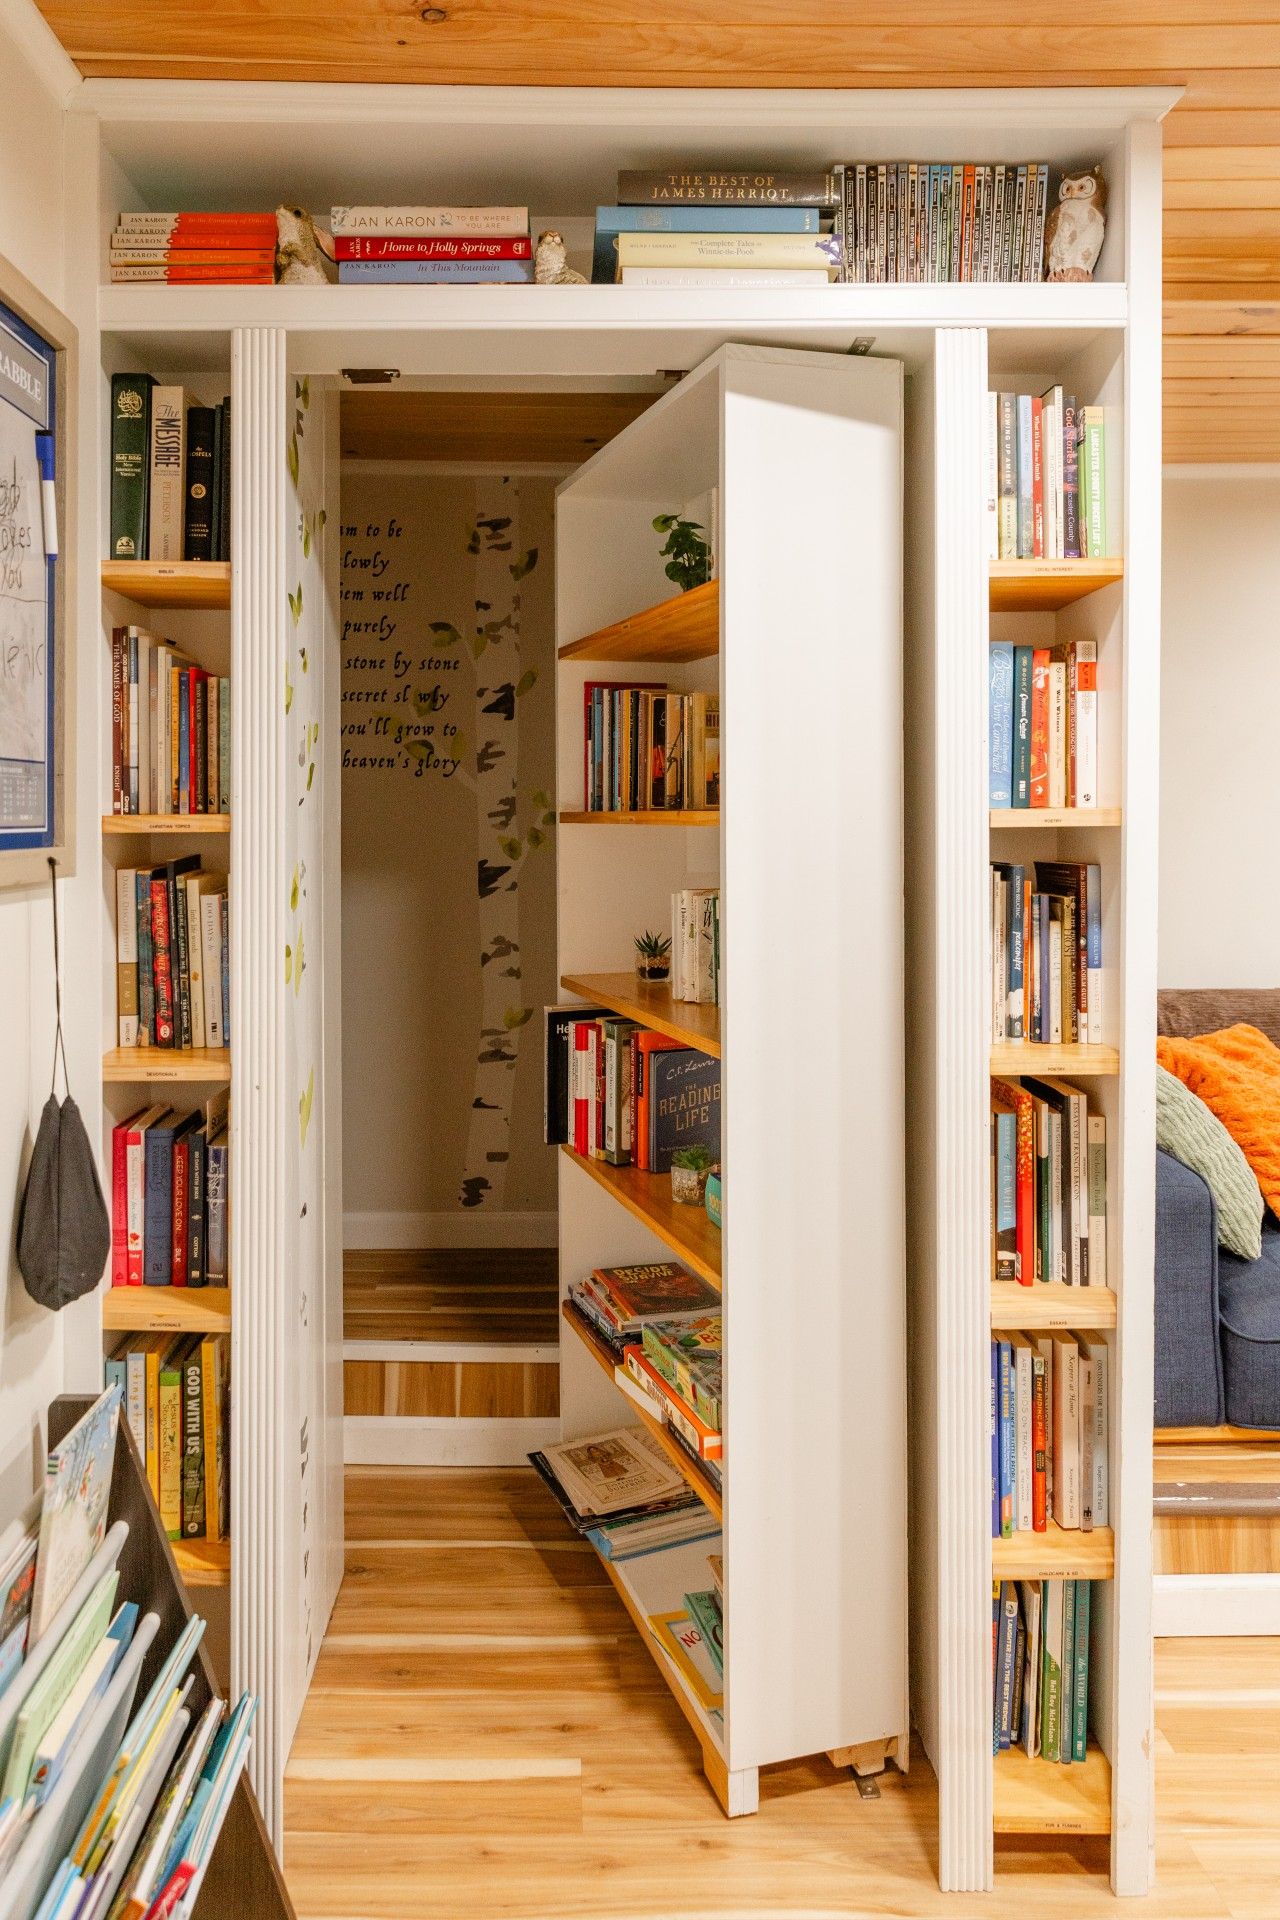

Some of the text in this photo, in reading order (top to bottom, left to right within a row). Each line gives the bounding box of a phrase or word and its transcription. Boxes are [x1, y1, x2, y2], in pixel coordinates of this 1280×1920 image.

[651, 188, 789, 199] JAMES HERRIOT
[668, 175, 775, 187] THE BEST OF
[350, 217, 436, 227] JAN KARON
[379, 241, 501, 255] Home to Holly Springs
[417, 263, 500, 272] In This Mountain
[156, 404, 180, 418] The
[1065, 407, 1075, 428] God
[154, 418, 181, 468] MESSAGE
[1004, 444, 1011, 455] UP
[1065, 430, 1075, 464] Stories
[1090, 428, 1101, 545] LANCASTER COUNTY BUCKET LIST
[366, 524, 380, 538] to
[387, 519, 403, 538] be
[1066, 517, 1075, 543] County
[340, 550, 390, 577] lowly
[372, 583, 410, 602] well
[343, 615, 396, 641] purely
[344, 651, 460, 677] stone by stone
[991, 649, 1011, 699] Breezes
[114, 691, 121, 701] OF
[341, 689, 388, 703] secret
[340, 717, 457, 744] you'll grow to
[992, 702, 1003, 773] Amy Carmichael
[342, 749, 460, 778] heaven's glory
[155, 895, 166, 970] WHISPERS OF HIS POWER
[1063, 928, 1073, 958] FROST
[1012, 931, 1022, 972] peacemaker
[159, 976, 169, 1017] CARMICHAEL
[660, 1083, 721, 1117] READING
[675, 1105, 709, 1132] LIFE
[1073, 1130, 1079, 1140] OF
[175, 1155, 184, 1231] KEEP YOUR LOVE ON
[1003, 1187, 1012, 1223] WHITE
[612, 1265, 669, 1278] DECIDE
[187, 1366, 200, 1396] GOD
[168, 1400, 180, 1429] Jesus
[187, 1399, 200, 1434] WITH
[187, 1436, 200, 1455] US
[1096, 1465, 1104, 1483] Keepers
[680, 1629, 703, 1648] NO
[1077, 1657, 1086, 1707] the WORLD
[1048, 1695, 1057, 1707] Roy
[1048, 1708, 1056, 1743] McFarlane
